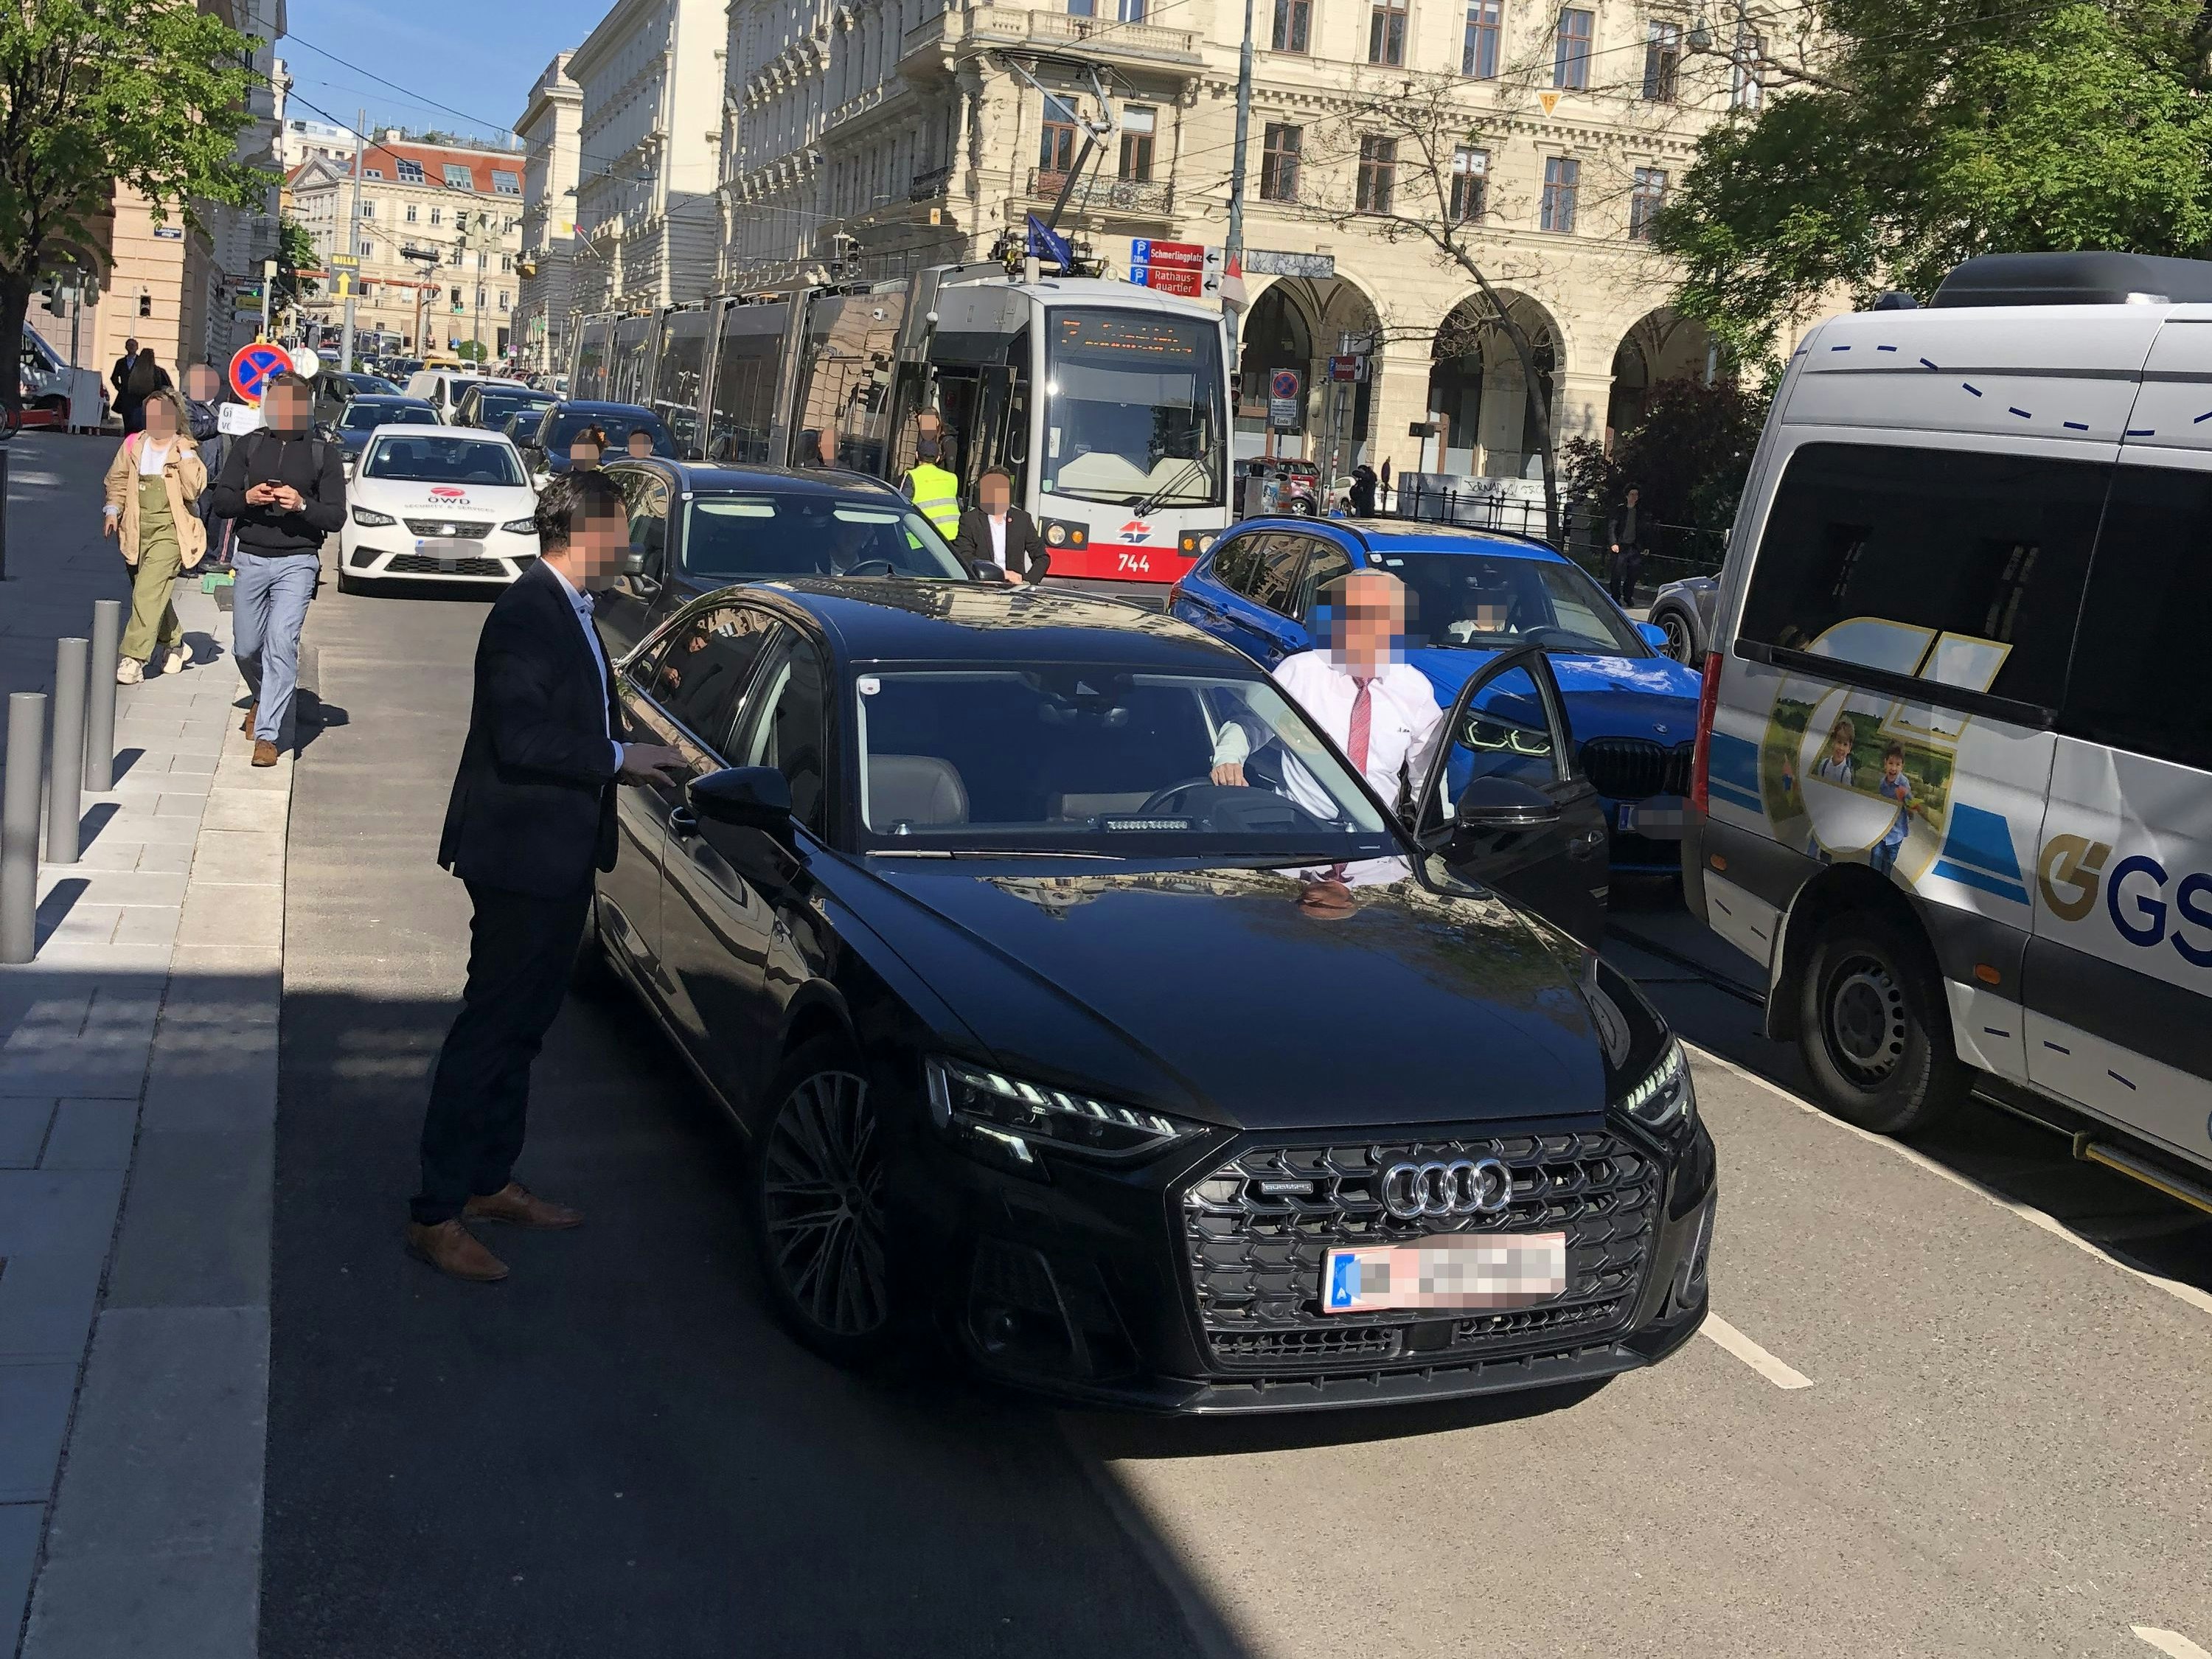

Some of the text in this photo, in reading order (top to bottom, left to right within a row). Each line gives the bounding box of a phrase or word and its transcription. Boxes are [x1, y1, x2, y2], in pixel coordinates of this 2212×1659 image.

[1543, 96, 1554, 105] 15
[332, 255, 358, 265] BILLA
[1151, 248, 1203, 263] Schmerlingplatz
[1155, 271, 1194, 282] Rathaus-
[1155, 283, 1193, 293] quartier
[428, 495, 470, 504] ÖWD
[1118, 553, 1150, 572] 744
[1336, 1287, 1347, 1299] A
